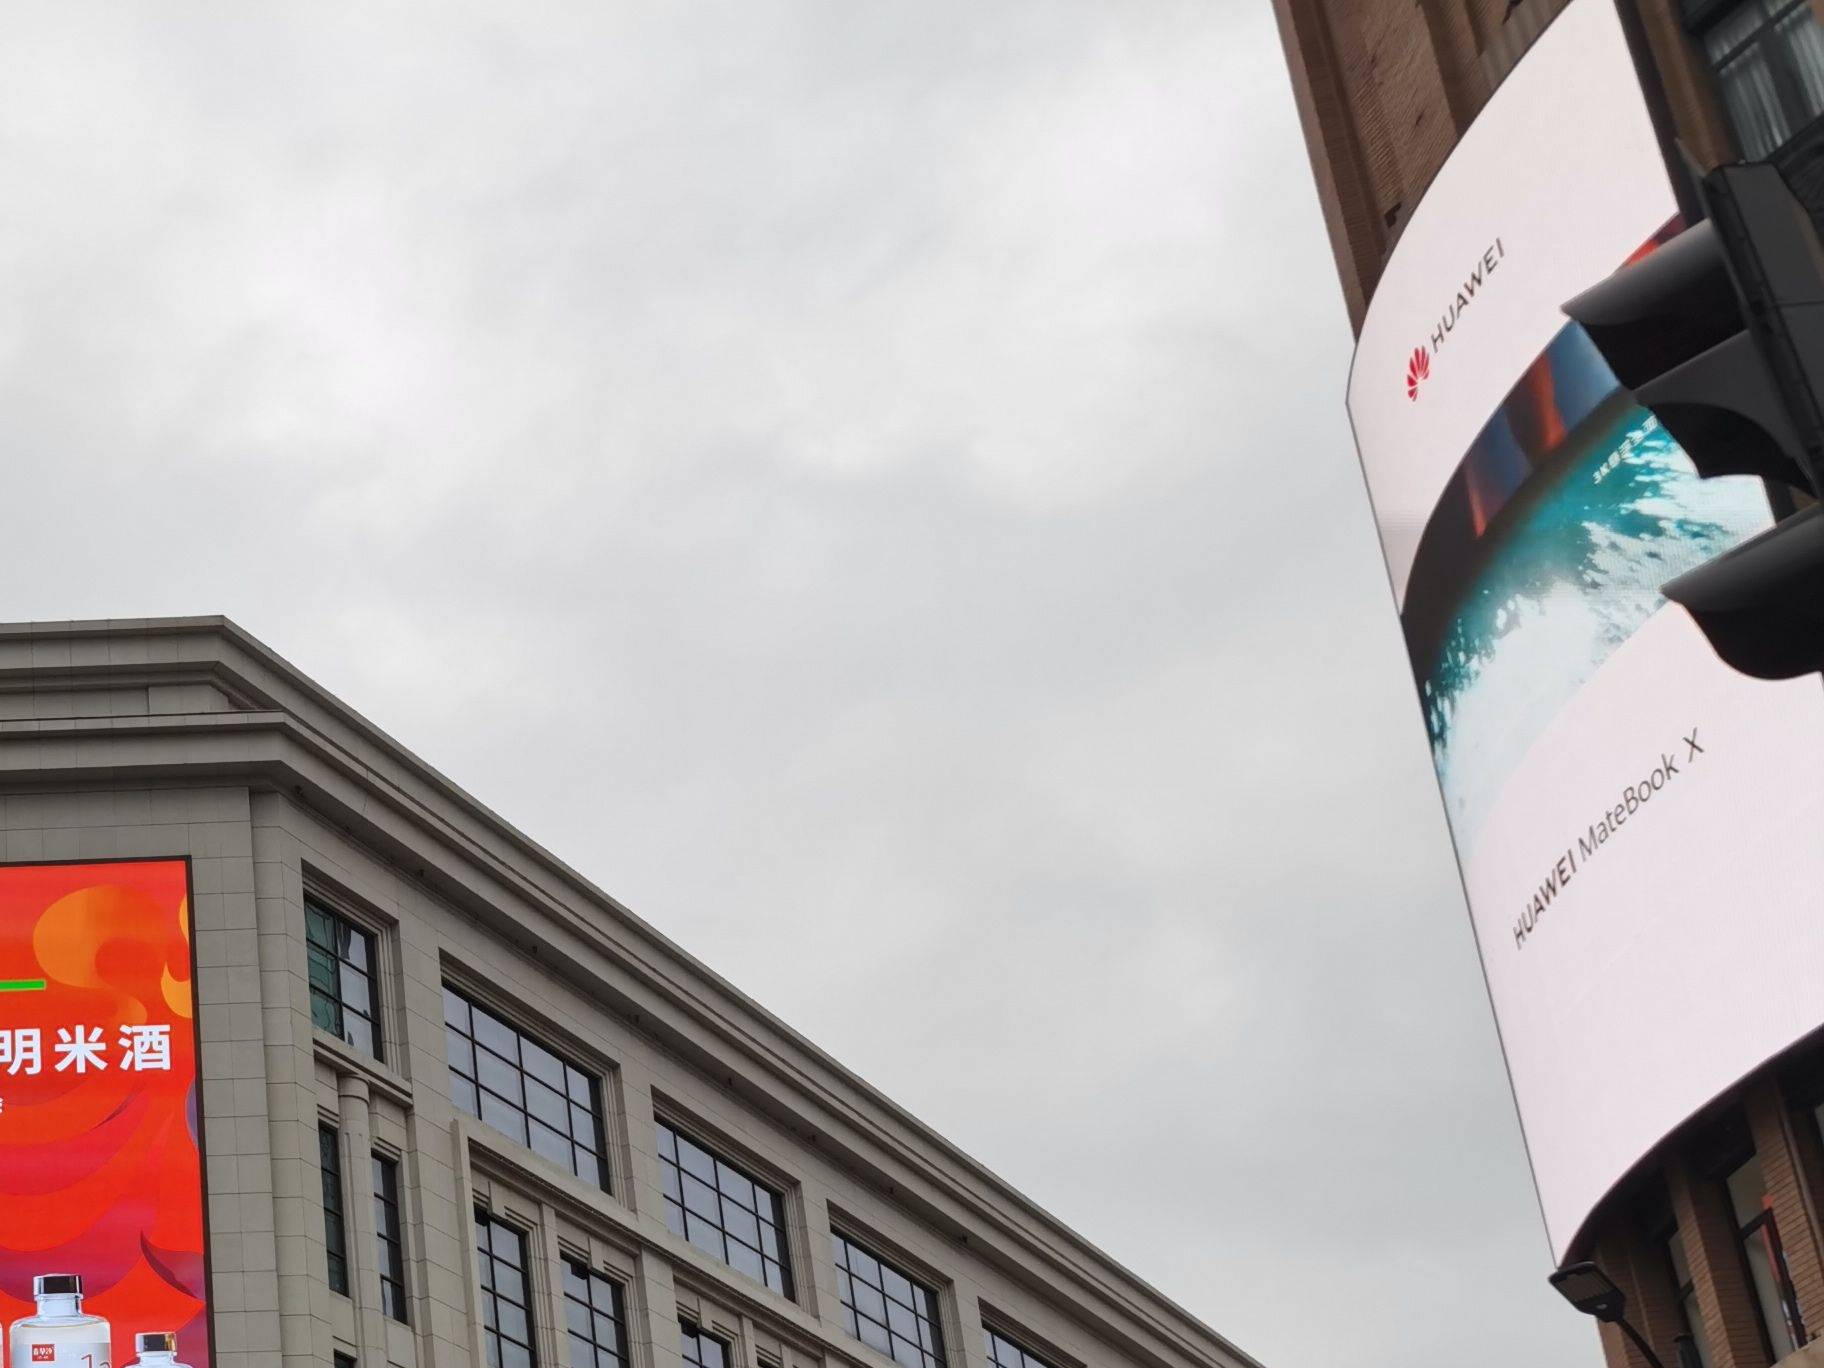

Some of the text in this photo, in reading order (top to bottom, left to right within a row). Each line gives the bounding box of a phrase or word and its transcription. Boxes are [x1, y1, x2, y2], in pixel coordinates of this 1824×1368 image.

[1430, 237, 1505, 353] HUAWEI
[1512, 727, 1705, 951] HUAWEI MateBook X
